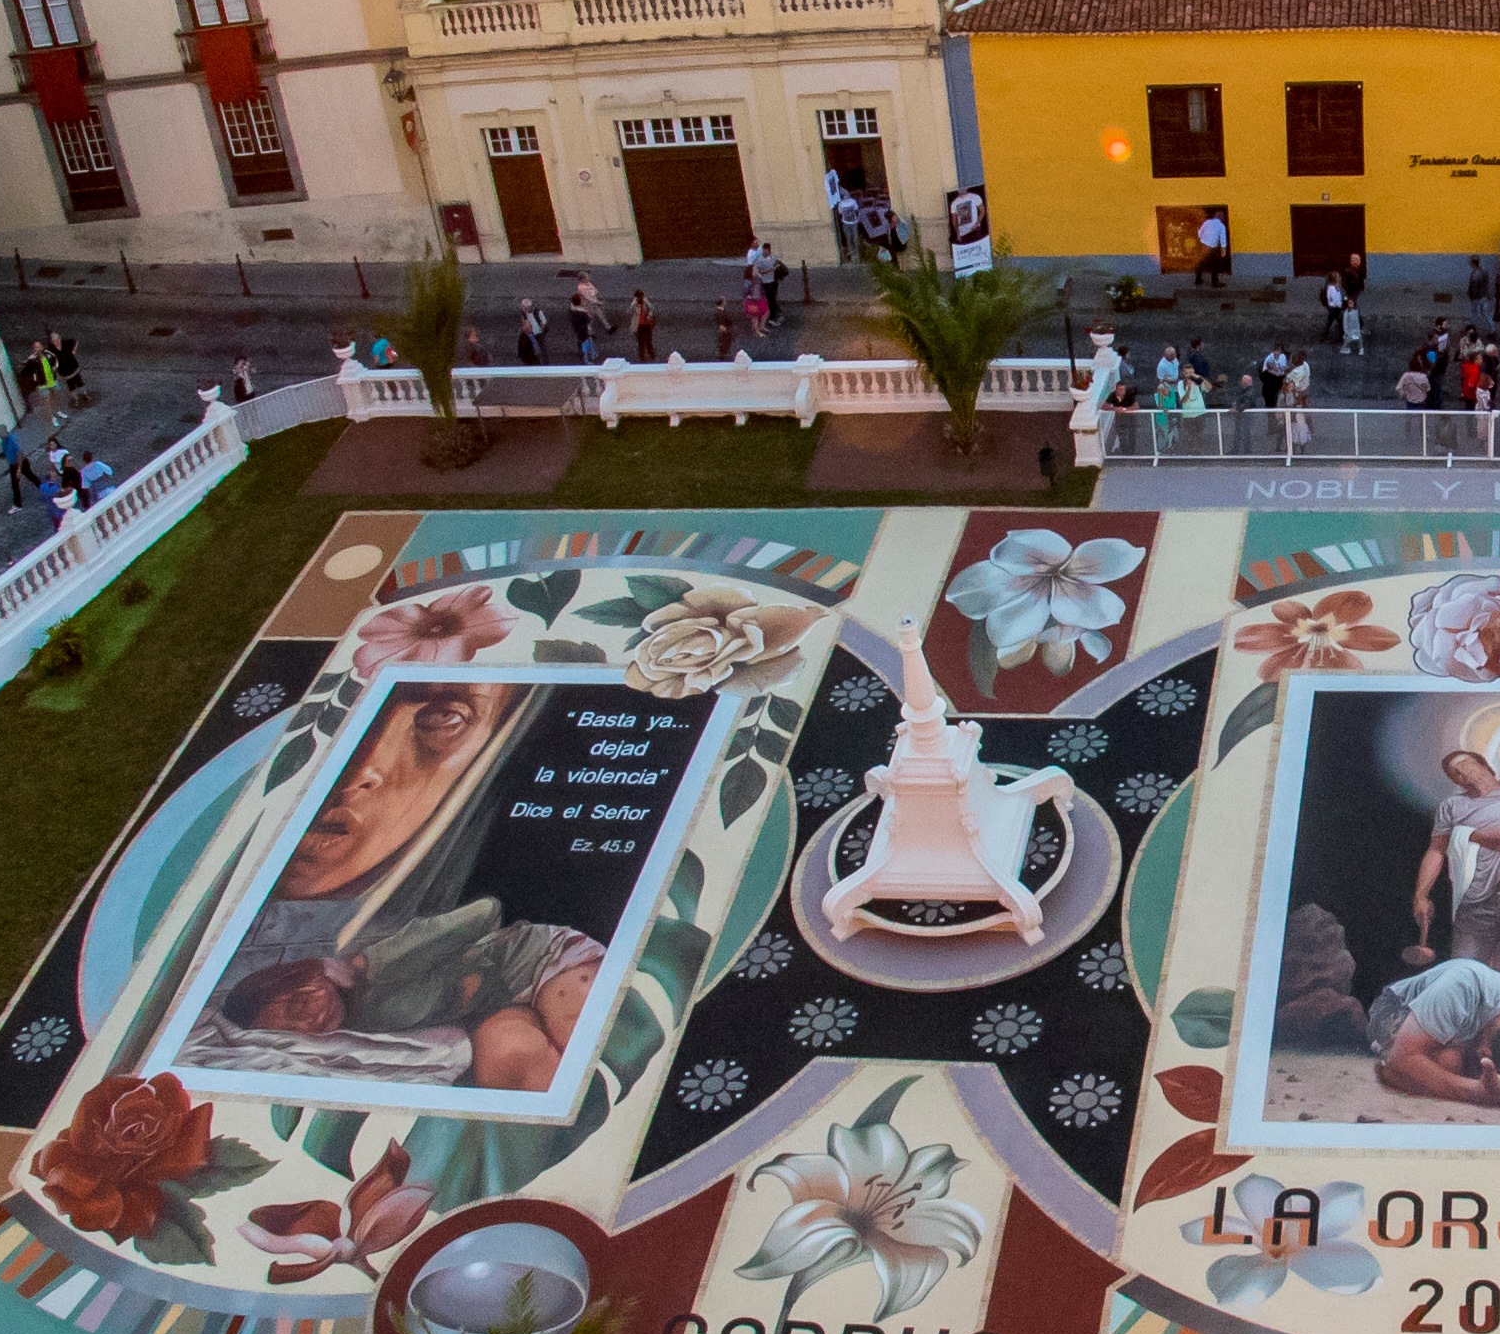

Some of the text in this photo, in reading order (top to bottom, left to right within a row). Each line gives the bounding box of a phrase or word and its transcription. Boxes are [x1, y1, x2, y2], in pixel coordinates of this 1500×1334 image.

[1245, 479, 1400, 501] NOBLE
[1432, 480, 1462, 501] Y
[645, 715, 690, 732] ya...
[589, 739, 651, 760] dejad
[534, 766, 555, 783] la
[510, 802, 651, 821] Dice el Señor
[570, 838, 594, 852] Ez.
[1202, 1186, 1321, 1247] LA
